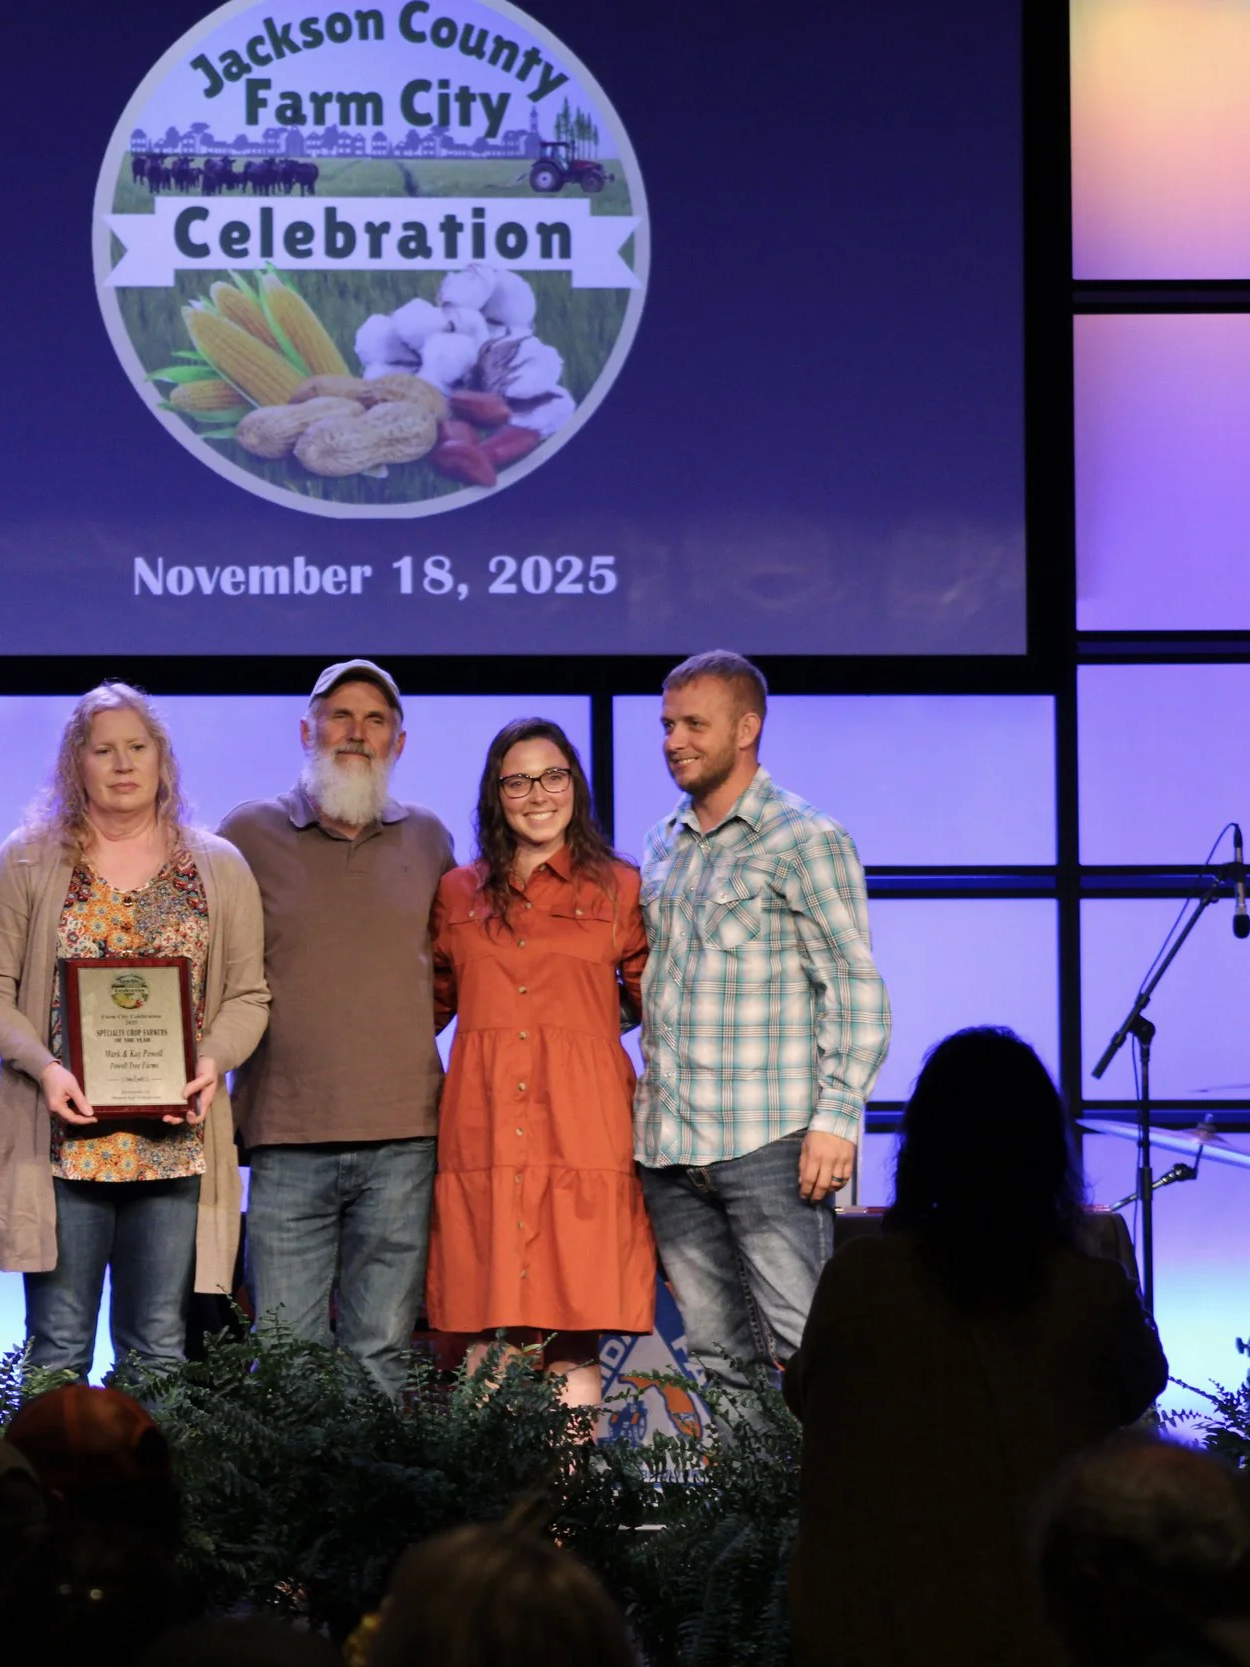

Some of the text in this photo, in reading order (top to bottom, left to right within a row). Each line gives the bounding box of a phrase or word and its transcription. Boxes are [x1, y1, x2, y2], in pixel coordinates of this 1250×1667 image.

[189, 1, 571, 102] Jackson County
[245, 78, 511, 139] Farm City
[173, 206, 573, 260] Celebration
[132, 555, 618, 600] November 18, 2025
